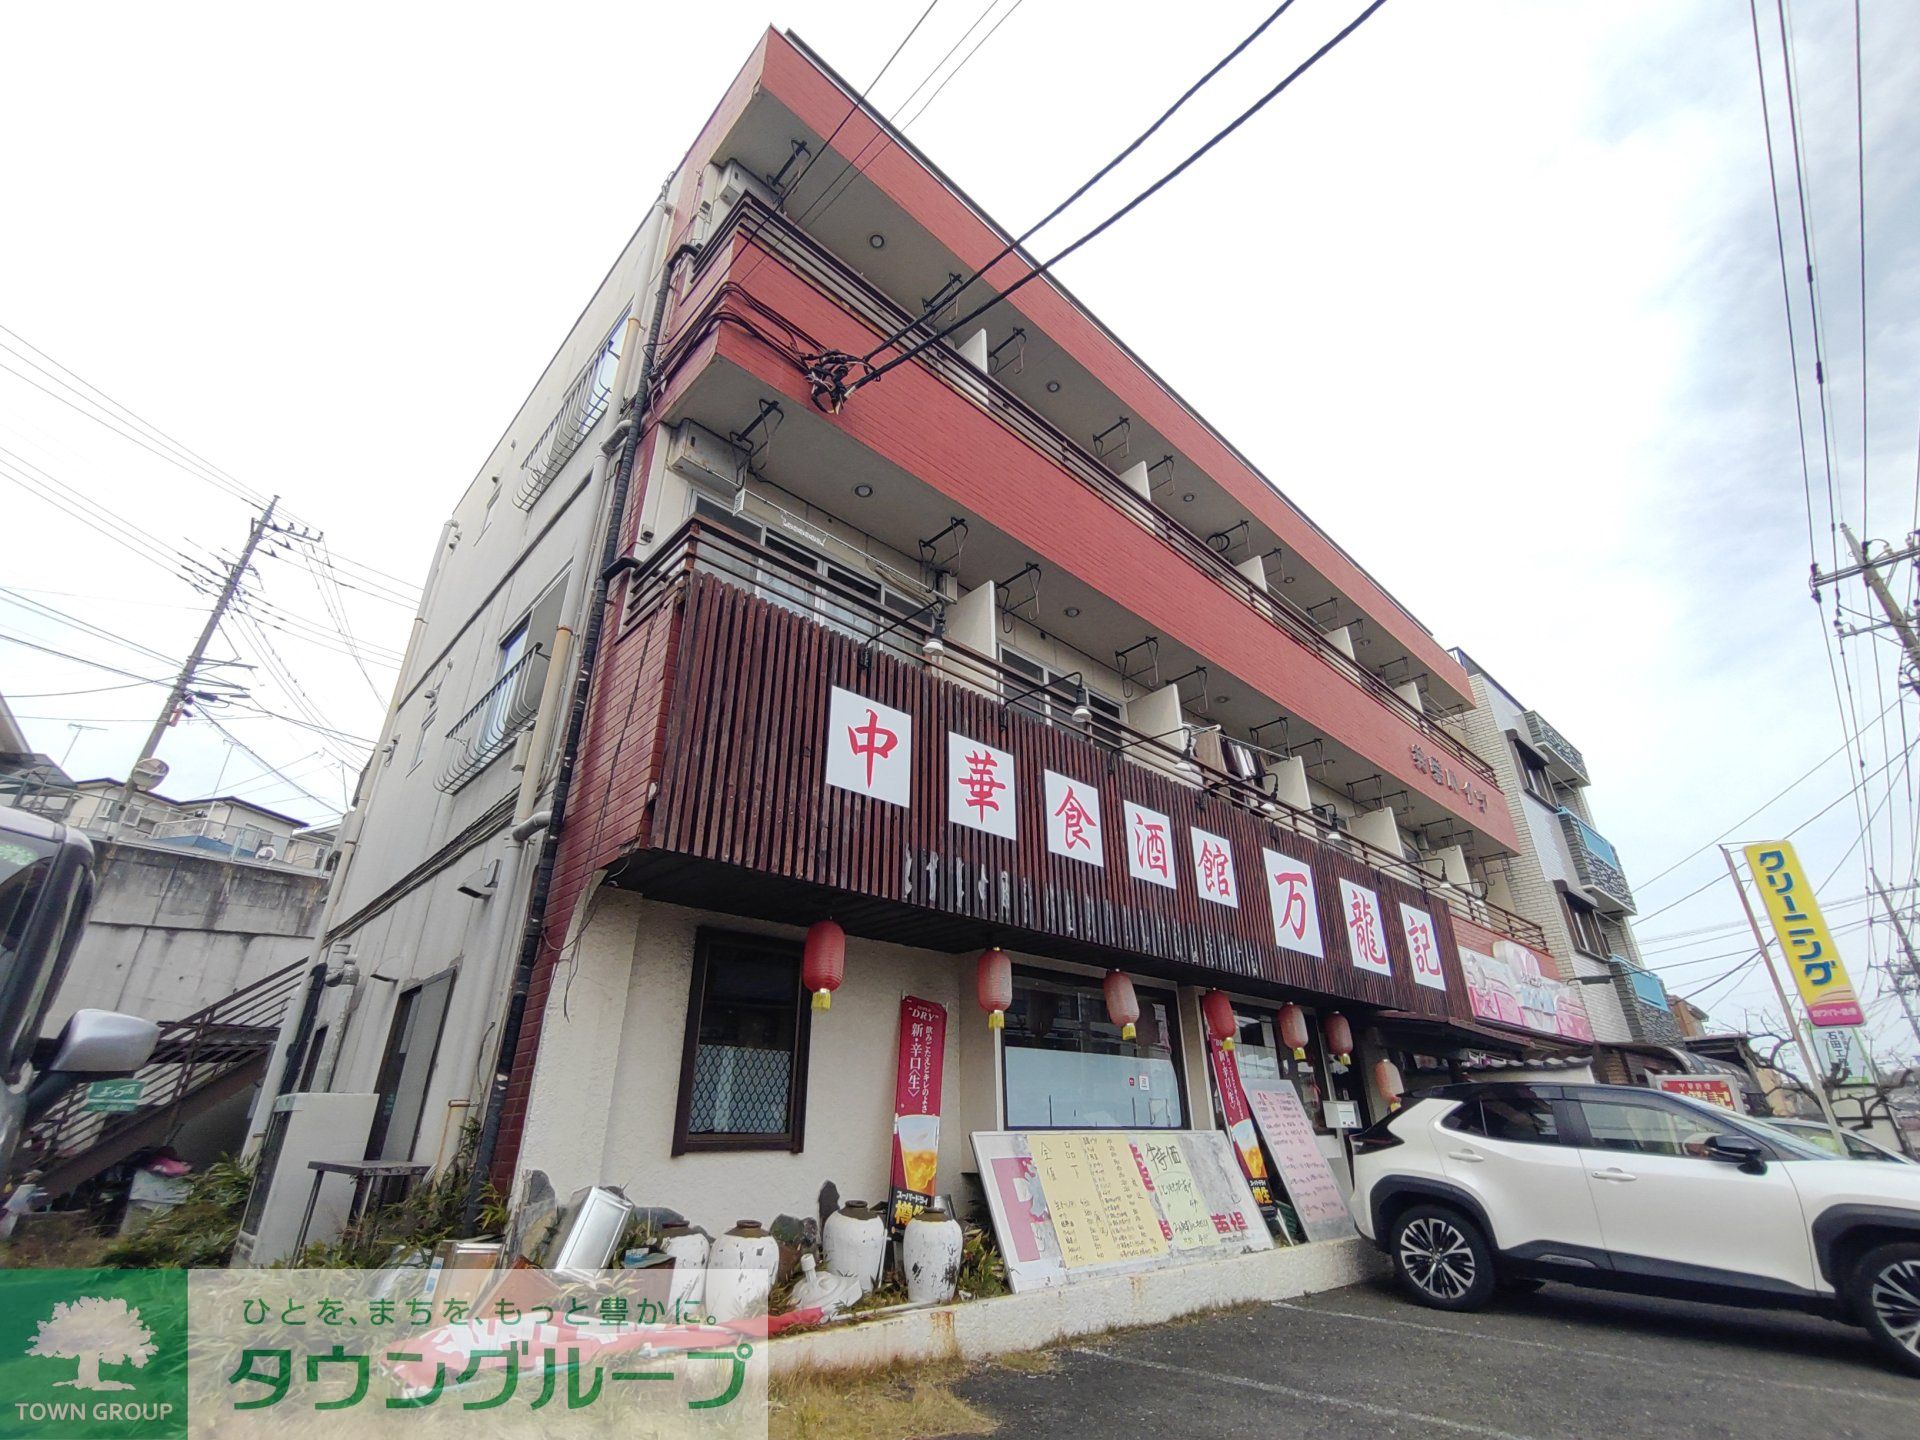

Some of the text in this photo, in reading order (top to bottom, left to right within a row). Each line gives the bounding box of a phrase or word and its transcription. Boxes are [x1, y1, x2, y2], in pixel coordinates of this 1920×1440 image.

[1759, 850, 1835, 986] クリーニング
[896, 1191, 929, 1206] スーパードライ
